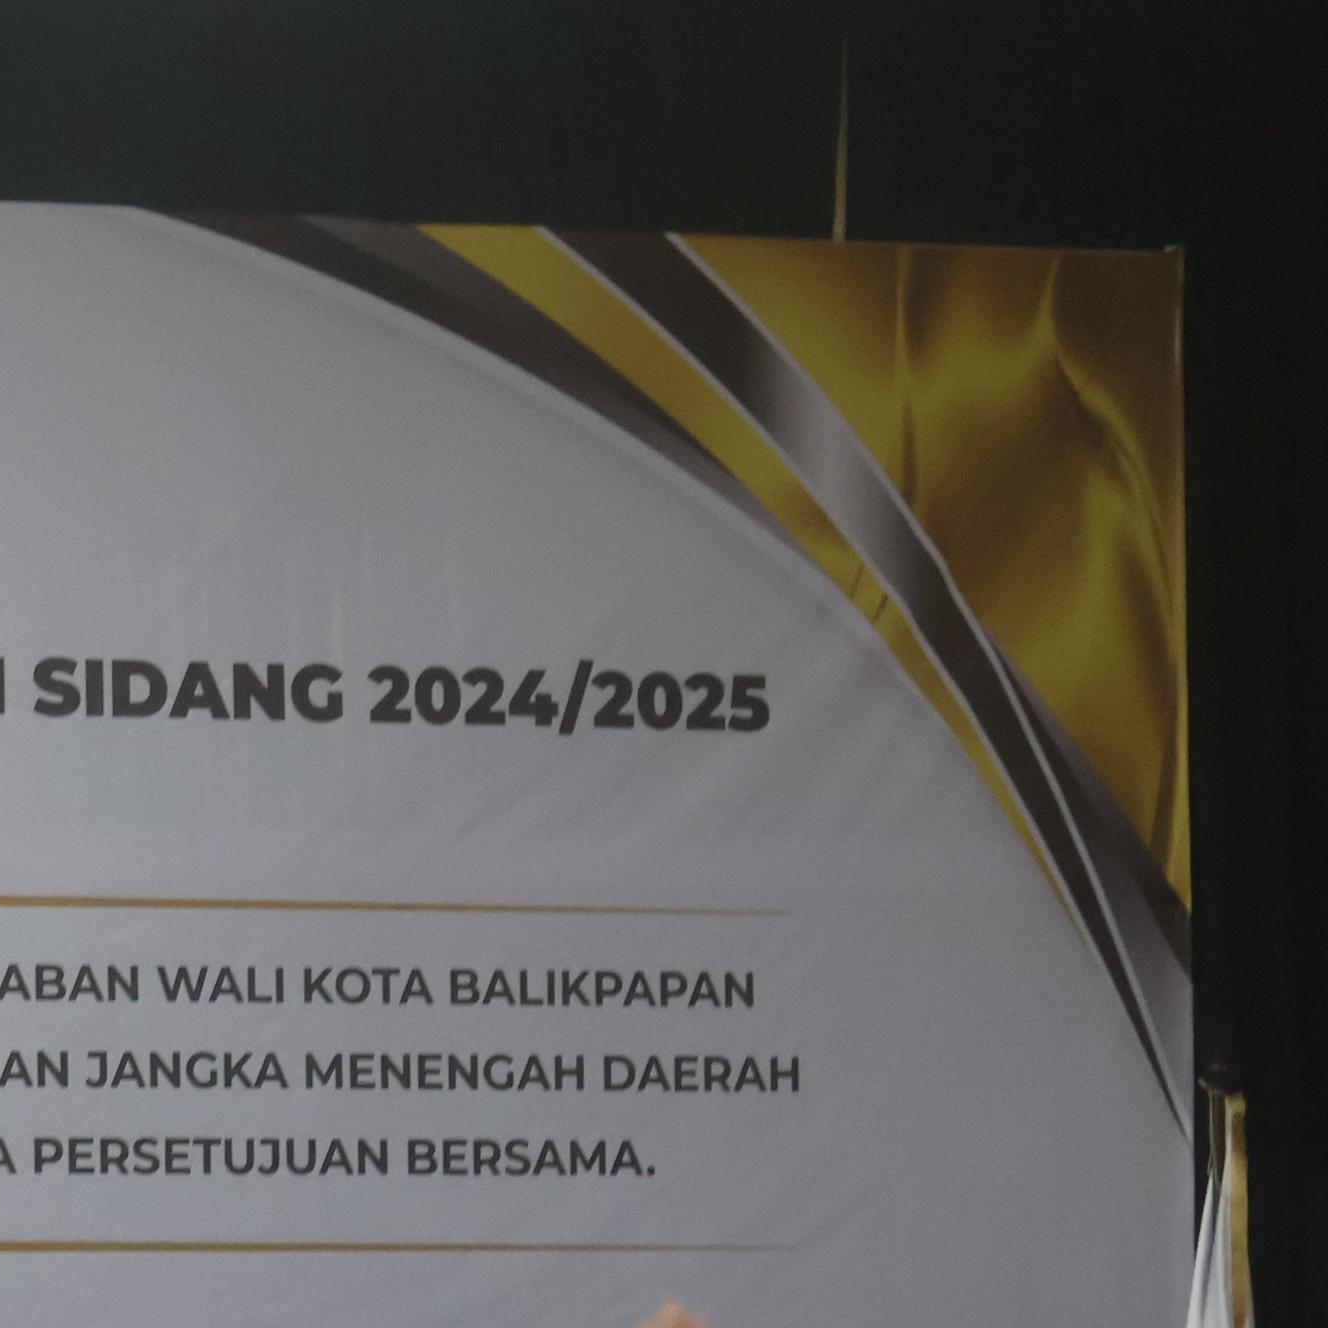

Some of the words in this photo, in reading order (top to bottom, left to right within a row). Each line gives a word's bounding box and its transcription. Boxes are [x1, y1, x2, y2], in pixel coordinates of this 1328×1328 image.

[32, 655, 344, 725] SIDANG
[366, 658, 771, 738] 2024/2025
[155, 964, 285, 1005] WALI
[303, 965, 435, 1007] KOTA
[449, 967, 755, 1010] BALIKPAPAN
[84, 1049, 290, 1091] JANGKA
[304, 1051, 585, 1093] MENENGAH
[602, 1054, 800, 1094] DAERAH
[32, 1135, 389, 1177] PERSETUJUAN
[406, 1137, 656, 1178] BERSAMA.
